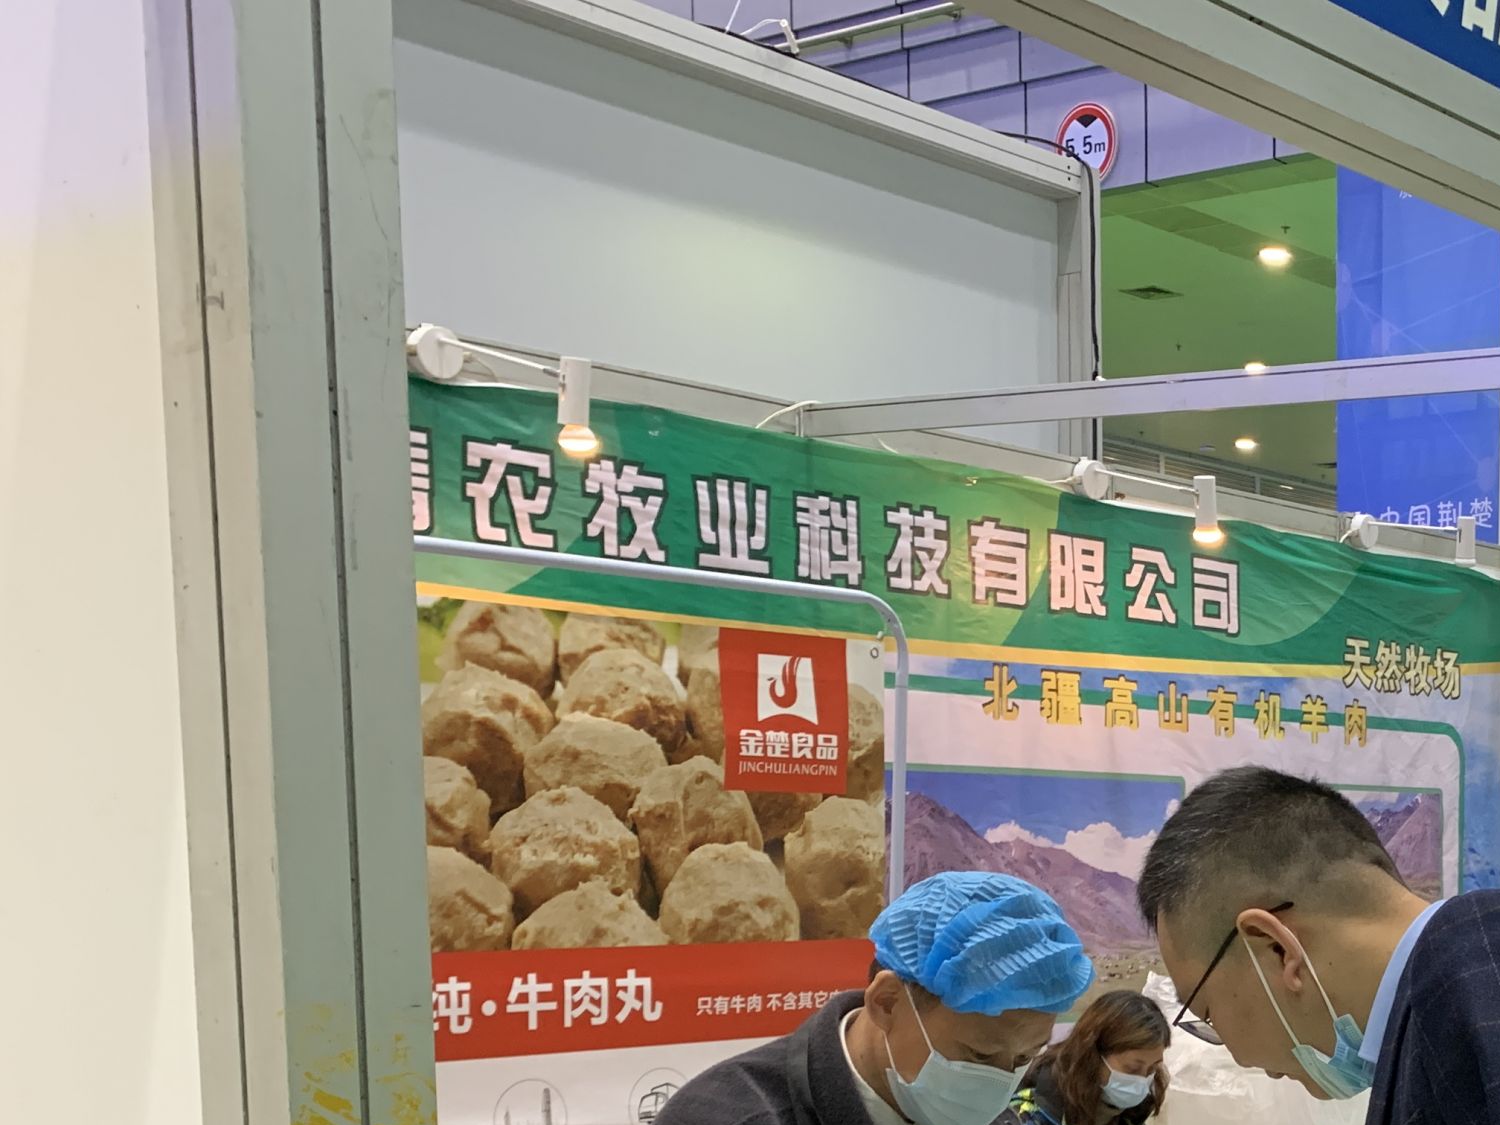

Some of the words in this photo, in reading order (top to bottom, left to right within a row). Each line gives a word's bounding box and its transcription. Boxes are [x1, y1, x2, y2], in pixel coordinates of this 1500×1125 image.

[1343, 638, 1461, 699] 天然牧场
[982, 663, 1368, 747] 北疆高山有机羊肉
[739, 729, 838, 760] 金楚良品
[738, 760, 838, 776] JINCHULIANGPIN
[696, 995, 763, 1016] 只有牛肉
